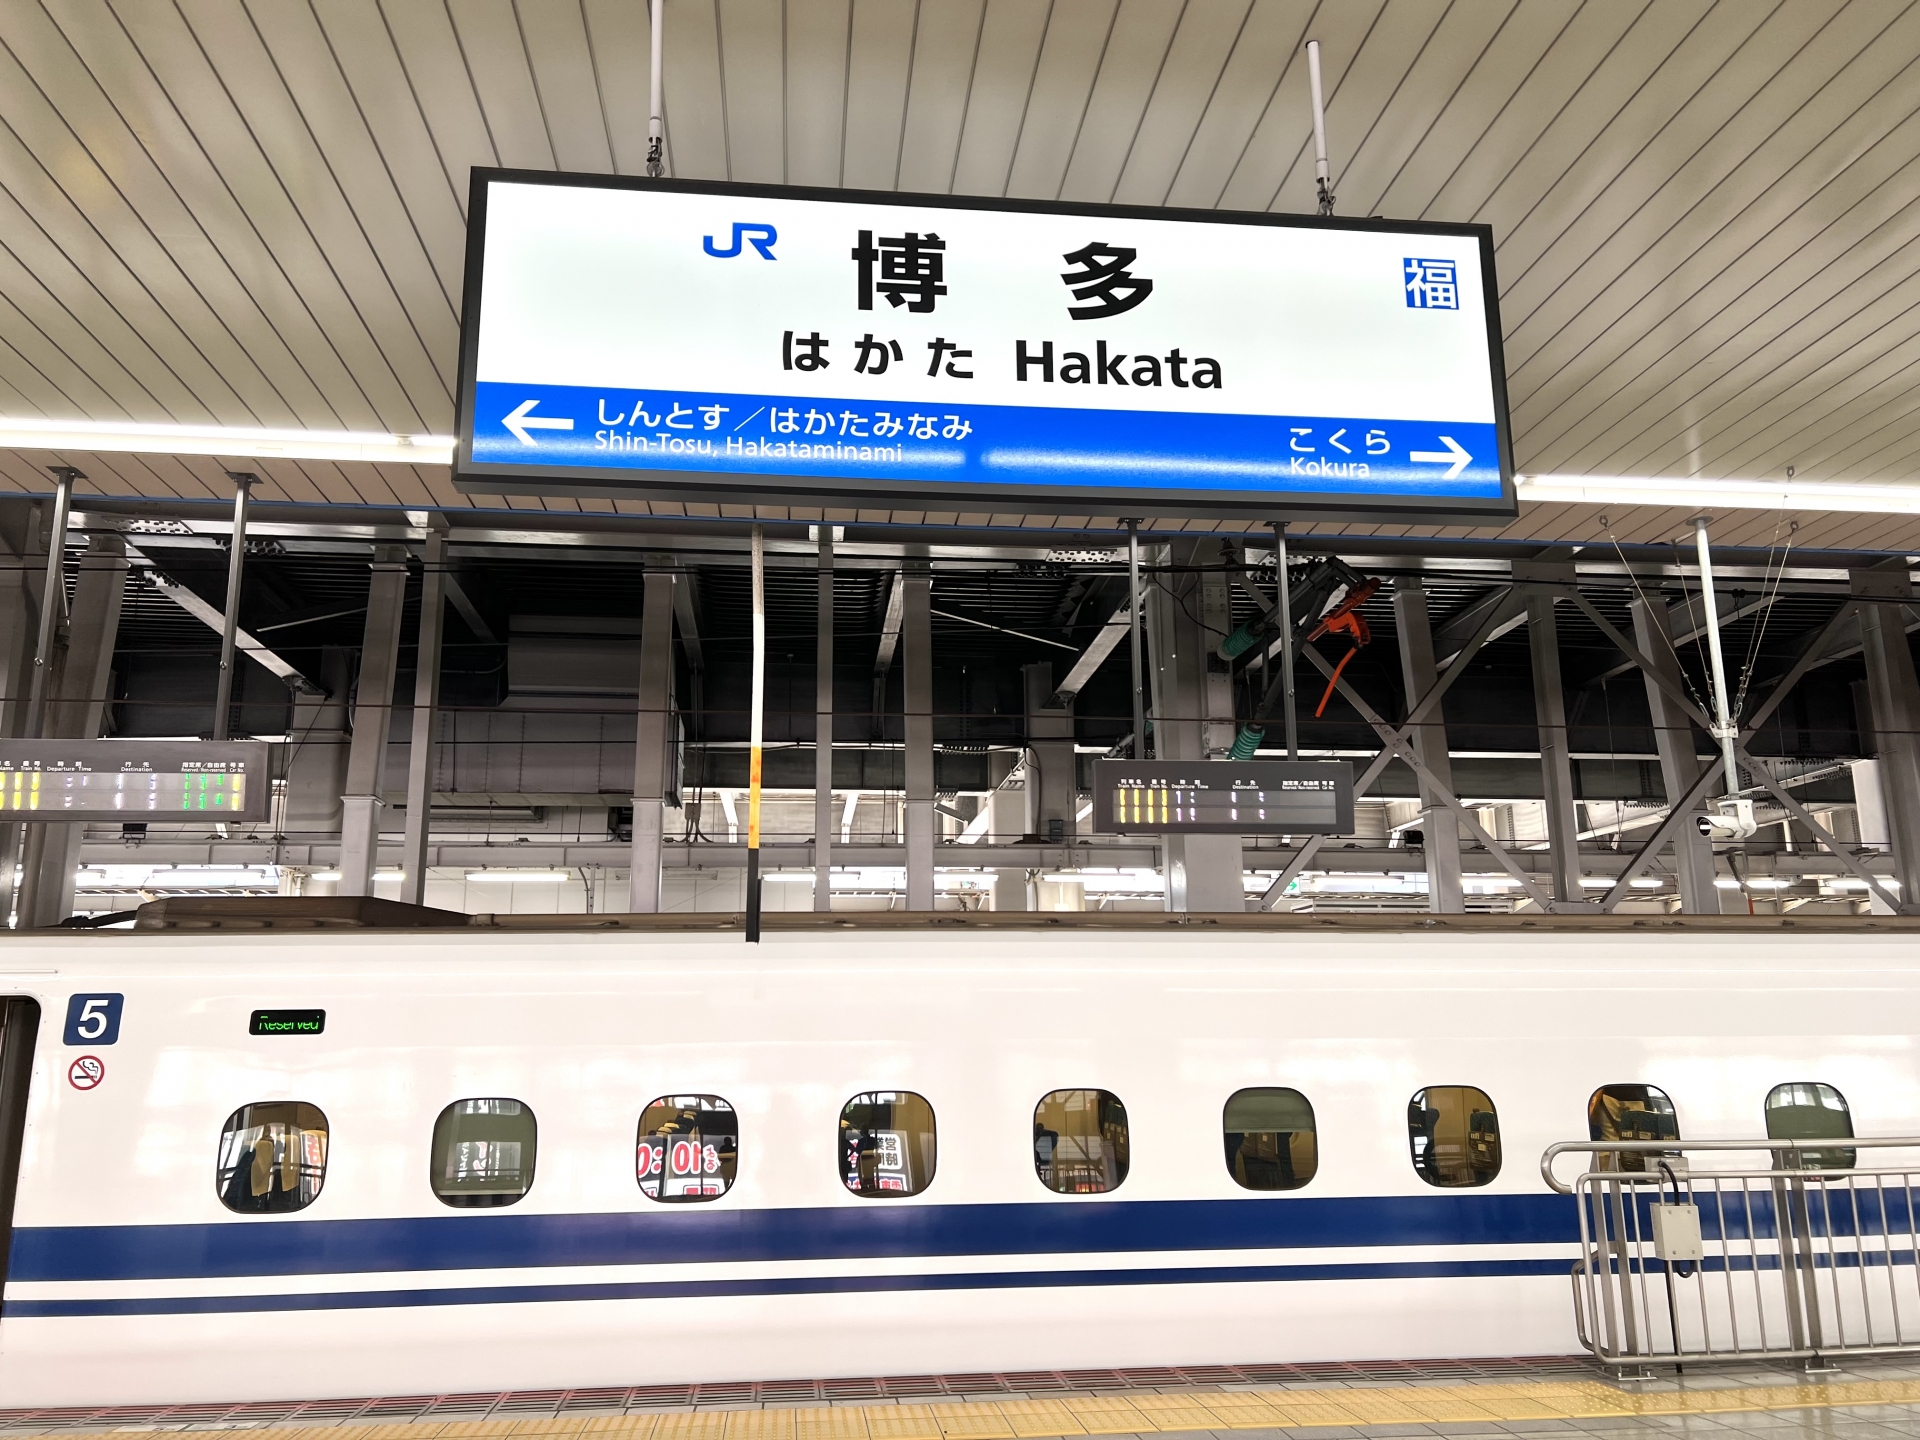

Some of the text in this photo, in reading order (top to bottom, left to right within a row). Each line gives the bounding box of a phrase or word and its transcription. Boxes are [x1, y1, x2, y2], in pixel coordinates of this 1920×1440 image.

[703, 221, 778, 261] JR
[852, 229, 1154, 321] 博多
[1404, 259, 1459, 310] 福
[782, 330, 1223, 390] はかた Hakata
[595, 430, 902, 463] Shin-Tosu, Hakataminami
[1289, 427, 1391, 456] こくら
[1290, 456, 1370, 479] Kokura
[77, 999, 109, 1038] 5
